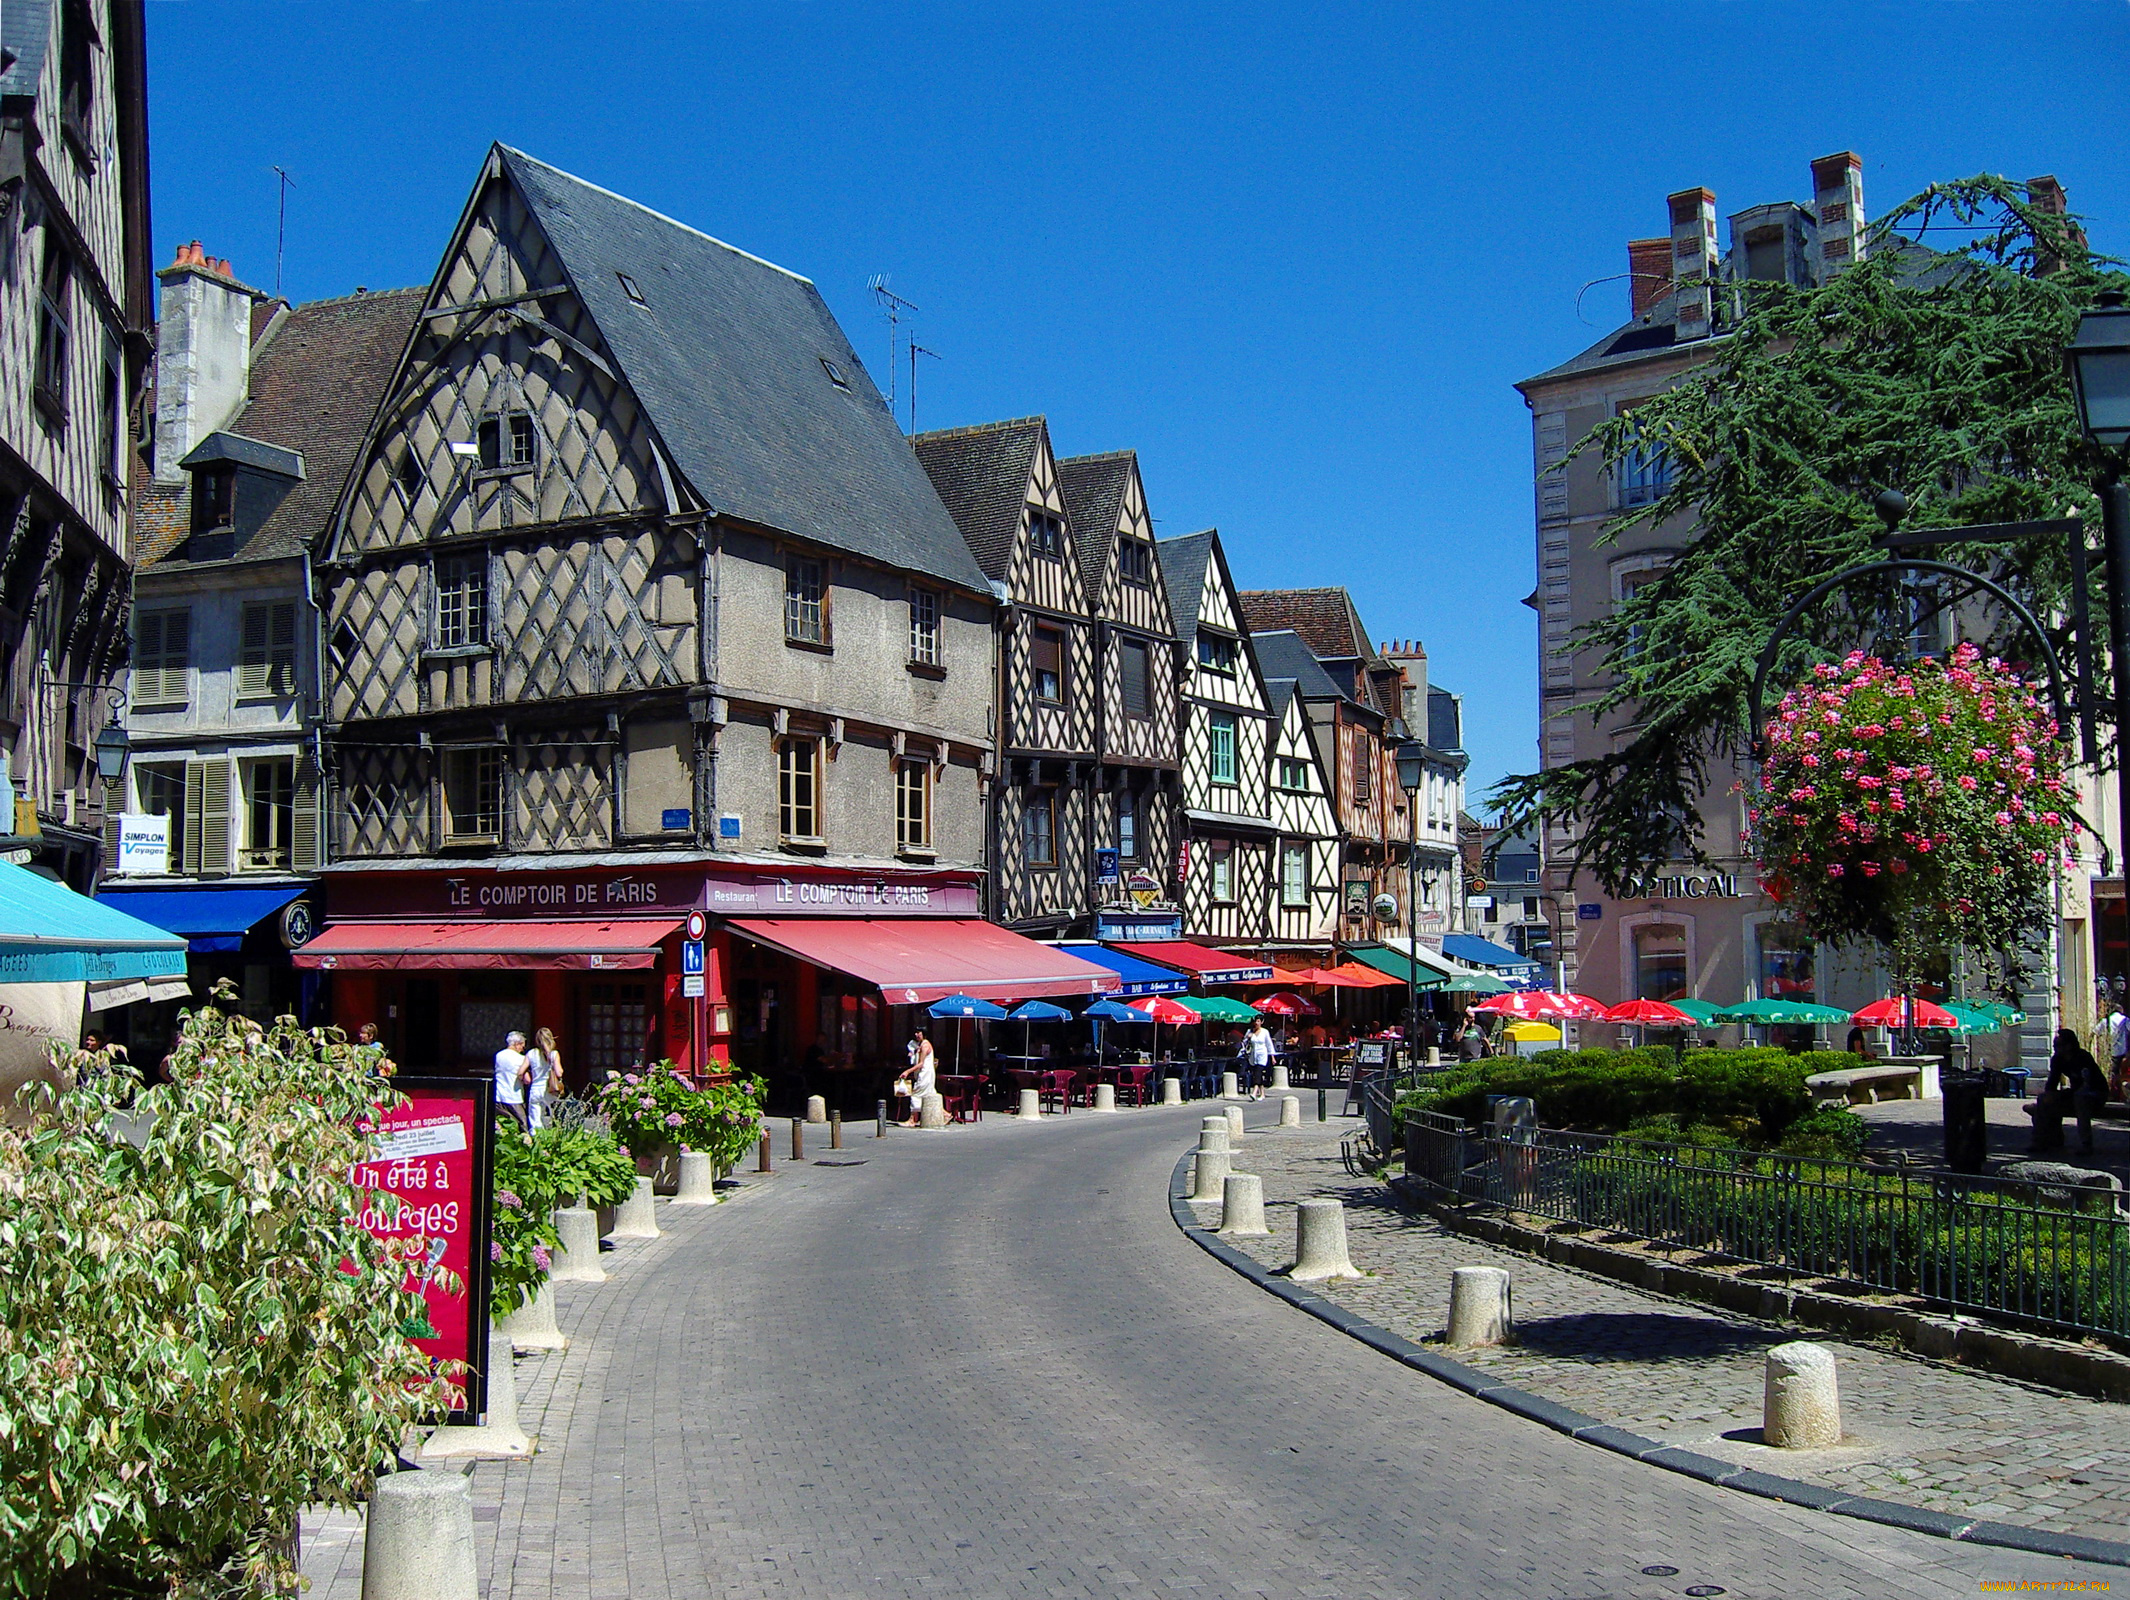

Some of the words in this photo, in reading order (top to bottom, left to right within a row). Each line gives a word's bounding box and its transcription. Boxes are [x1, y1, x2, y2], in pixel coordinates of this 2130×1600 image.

[124, 832, 165, 842] SIMPLON
[125, 843, 165, 855] Voyages
[1177, 841, 1187, 882] TABAC
[451, 886, 470, 905] LE
[479, 885, 566, 905] COMPTOIR
[576, 883, 598, 903] DE
[606, 882, 658, 903] PARIS
[776, 882, 793, 902] LE
[800, 883, 866, 905] COMPTOIR
[872, 884, 889, 904] DE
[895, 886, 929, 905] PARIS
[1131, 984, 1143, 993] BAR
[392, 1118, 410, 1131] jour,
[411, 1118, 422, 1128] un
[423, 1113, 461, 1128] spectacle
[409, 1131, 417, 1140] 23
[387, 1157, 428, 1189] été
[434, 1160, 450, 1190] à
[347, 1200, 460, 1257] ourges
